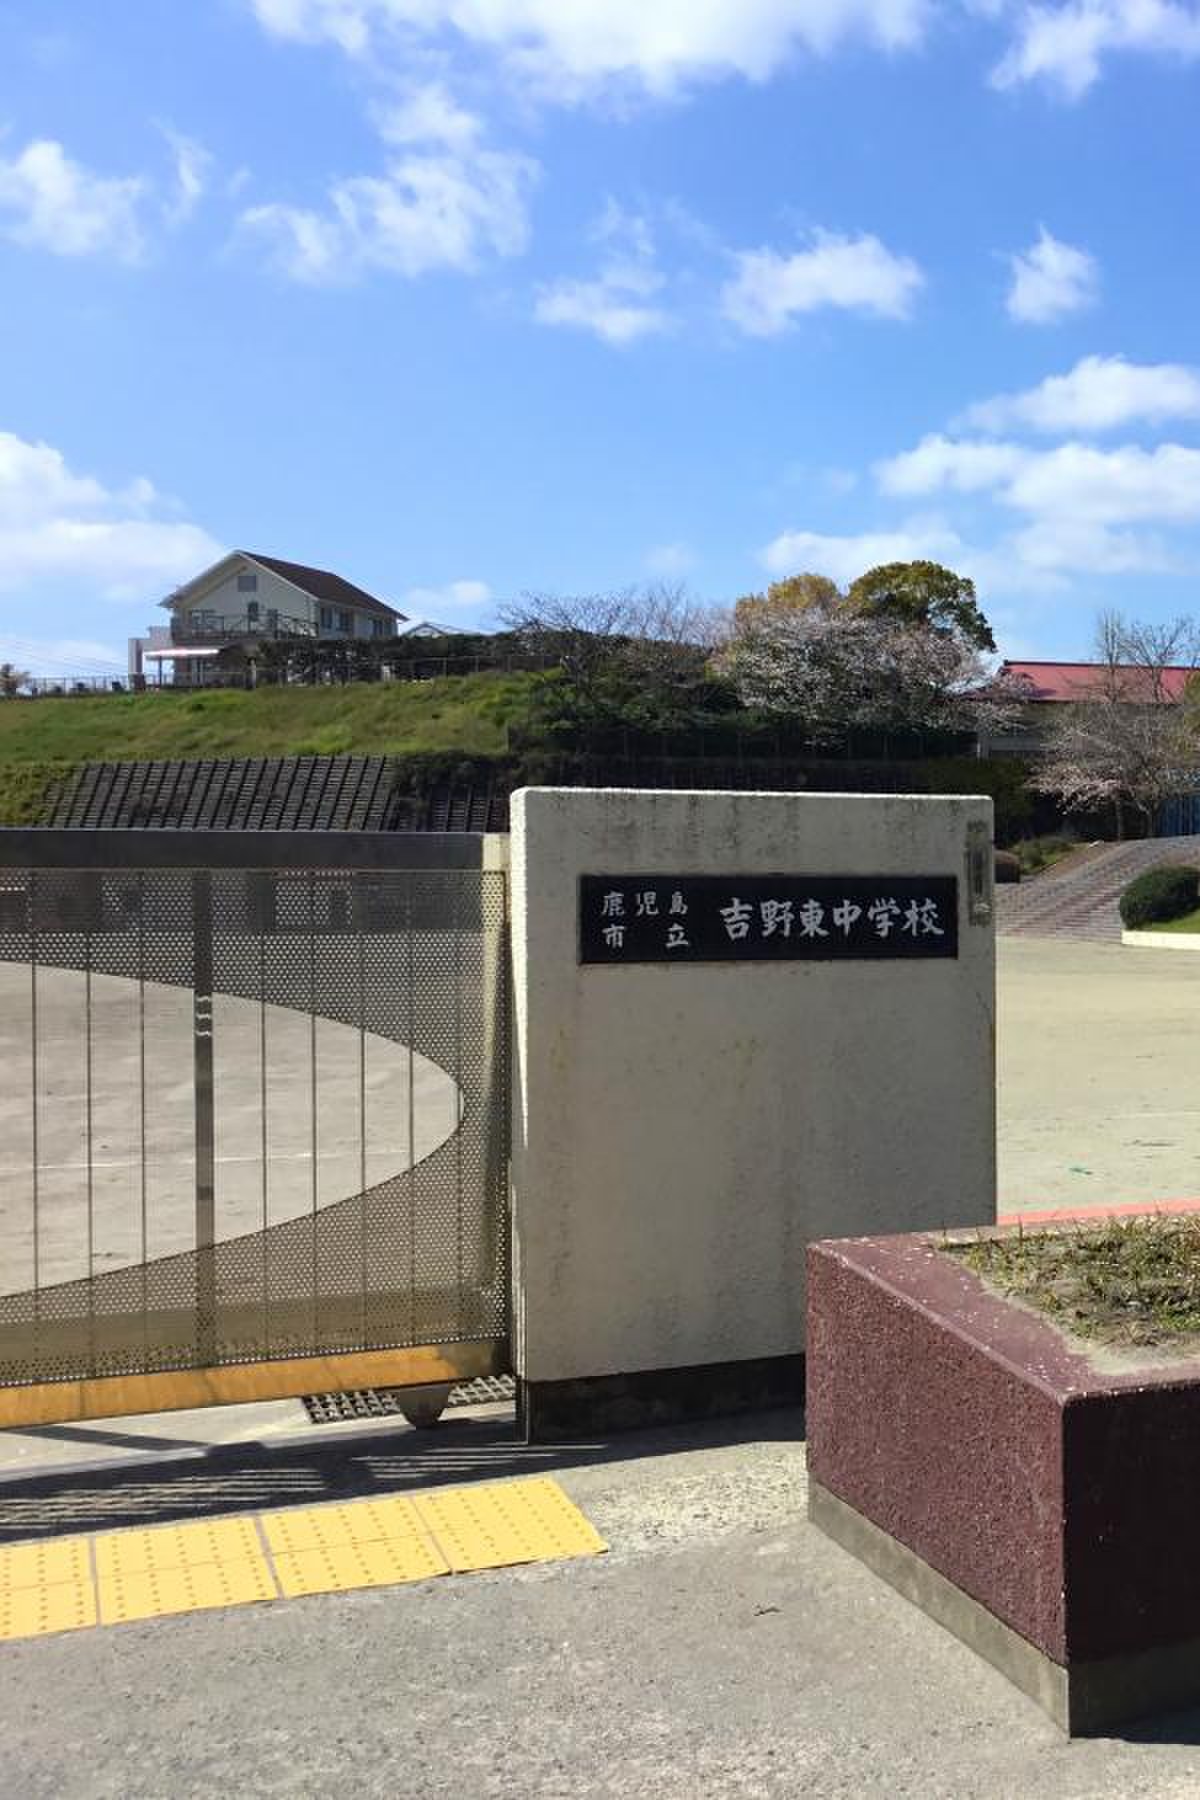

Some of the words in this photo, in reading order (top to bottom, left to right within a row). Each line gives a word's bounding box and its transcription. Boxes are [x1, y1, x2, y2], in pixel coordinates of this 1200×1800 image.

[601, 891, 689, 917] 鹿児島
[719, 897, 945, 940] 吉野東中学校
[602, 923, 690, 948] 市立
